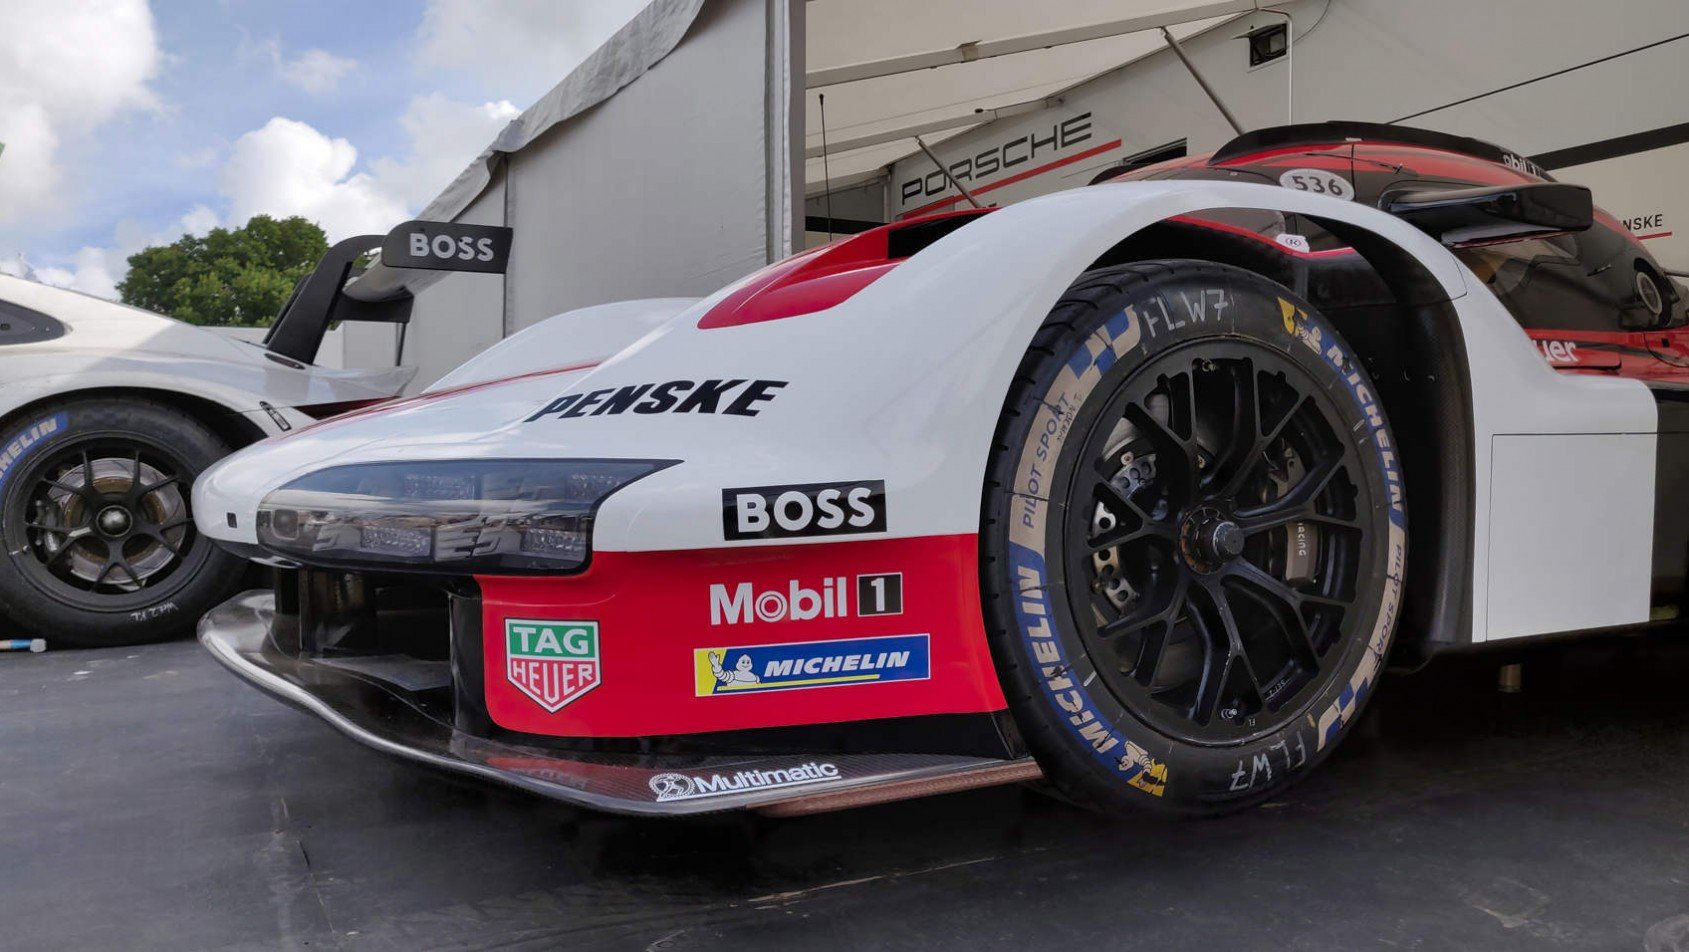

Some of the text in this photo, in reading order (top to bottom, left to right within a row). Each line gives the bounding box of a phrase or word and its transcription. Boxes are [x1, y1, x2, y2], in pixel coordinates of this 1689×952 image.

[902, 111, 1092, 206] PORSCHE
[1502, 153, 1527, 174] obil
[1292, 175, 1343, 196] 536
[1622, 213, 1663, 231] NSKE
[410, 233, 494, 261] BOSS
[1531, 339, 1579, 362] uer
[522, 379, 790, 423] PENSKE
[0, 418, 57, 478] HELIN
[1326, 344, 1402, 512] MICHELIN
[1022, 463, 1042, 529] PILOT
[1036, 392, 1070, 462] SPORT
[736, 487, 875, 534] BOSS
[1391, 544, 1403, 599] PILOT
[709, 576, 886, 626] Mobil 1
[512, 626, 589, 655] TAG
[1018, 565, 1120, 754] MICHELIN
[512, 660, 593, 704] HEUER
[764, 650, 911, 678] MICHELIN
[693, 762, 839, 794] Multimatic
